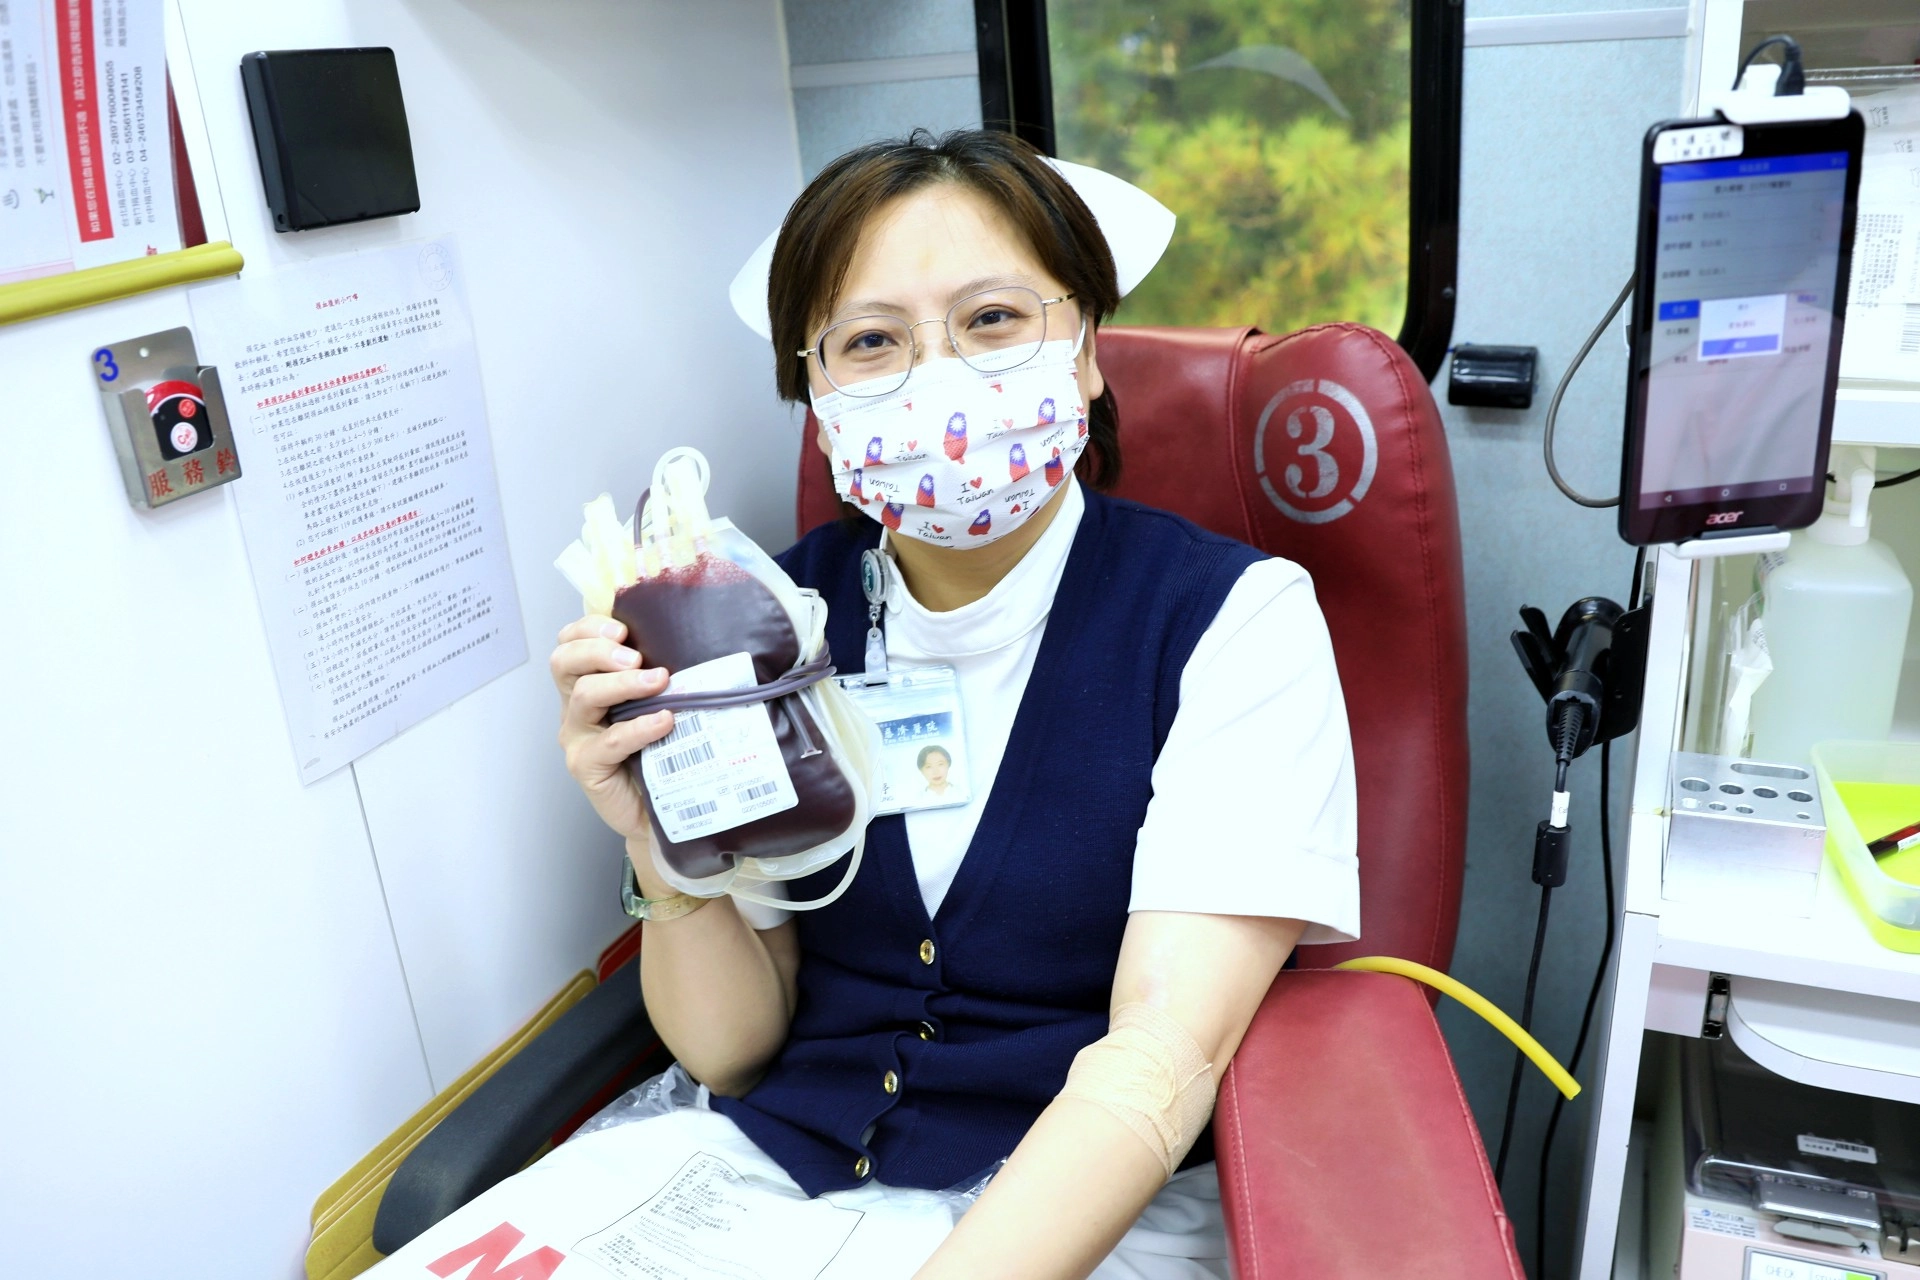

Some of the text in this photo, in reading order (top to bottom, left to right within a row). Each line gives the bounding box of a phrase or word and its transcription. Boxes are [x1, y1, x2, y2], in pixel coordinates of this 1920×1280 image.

[105, 60, 121, 165] 02-28971600#6055
[120, 73, 134, 163] 03-5556111#3141
[134, 66, 156, 223] 台中捐血中心 04-24612345#208
[115, 170, 129, 227] 台北捐血中心
[128, 169, 142, 225] 新竹捐血中心
[94, 348, 119, 382] 3
[1040, 427, 1066, 447] Taiwan
[285, 405, 339, 498] 3
[898, 442, 905, 452] I
[894, 453, 929, 462] Taiwan
[147, 447, 236, 498] 服務鈴
[869, 478, 900, 493] Taiwan
[961, 482, 970, 493] I
[956, 489, 994, 505] Taiwan
[1004, 489, 1035, 503] Taiwan
[1022, 501, 1030, 511] I
[922, 521, 931, 531] I
[1706, 511, 1744, 525] acer
[916, 527, 952, 540] Taiwan
[884, 720, 938, 739] 慈濟醫院
